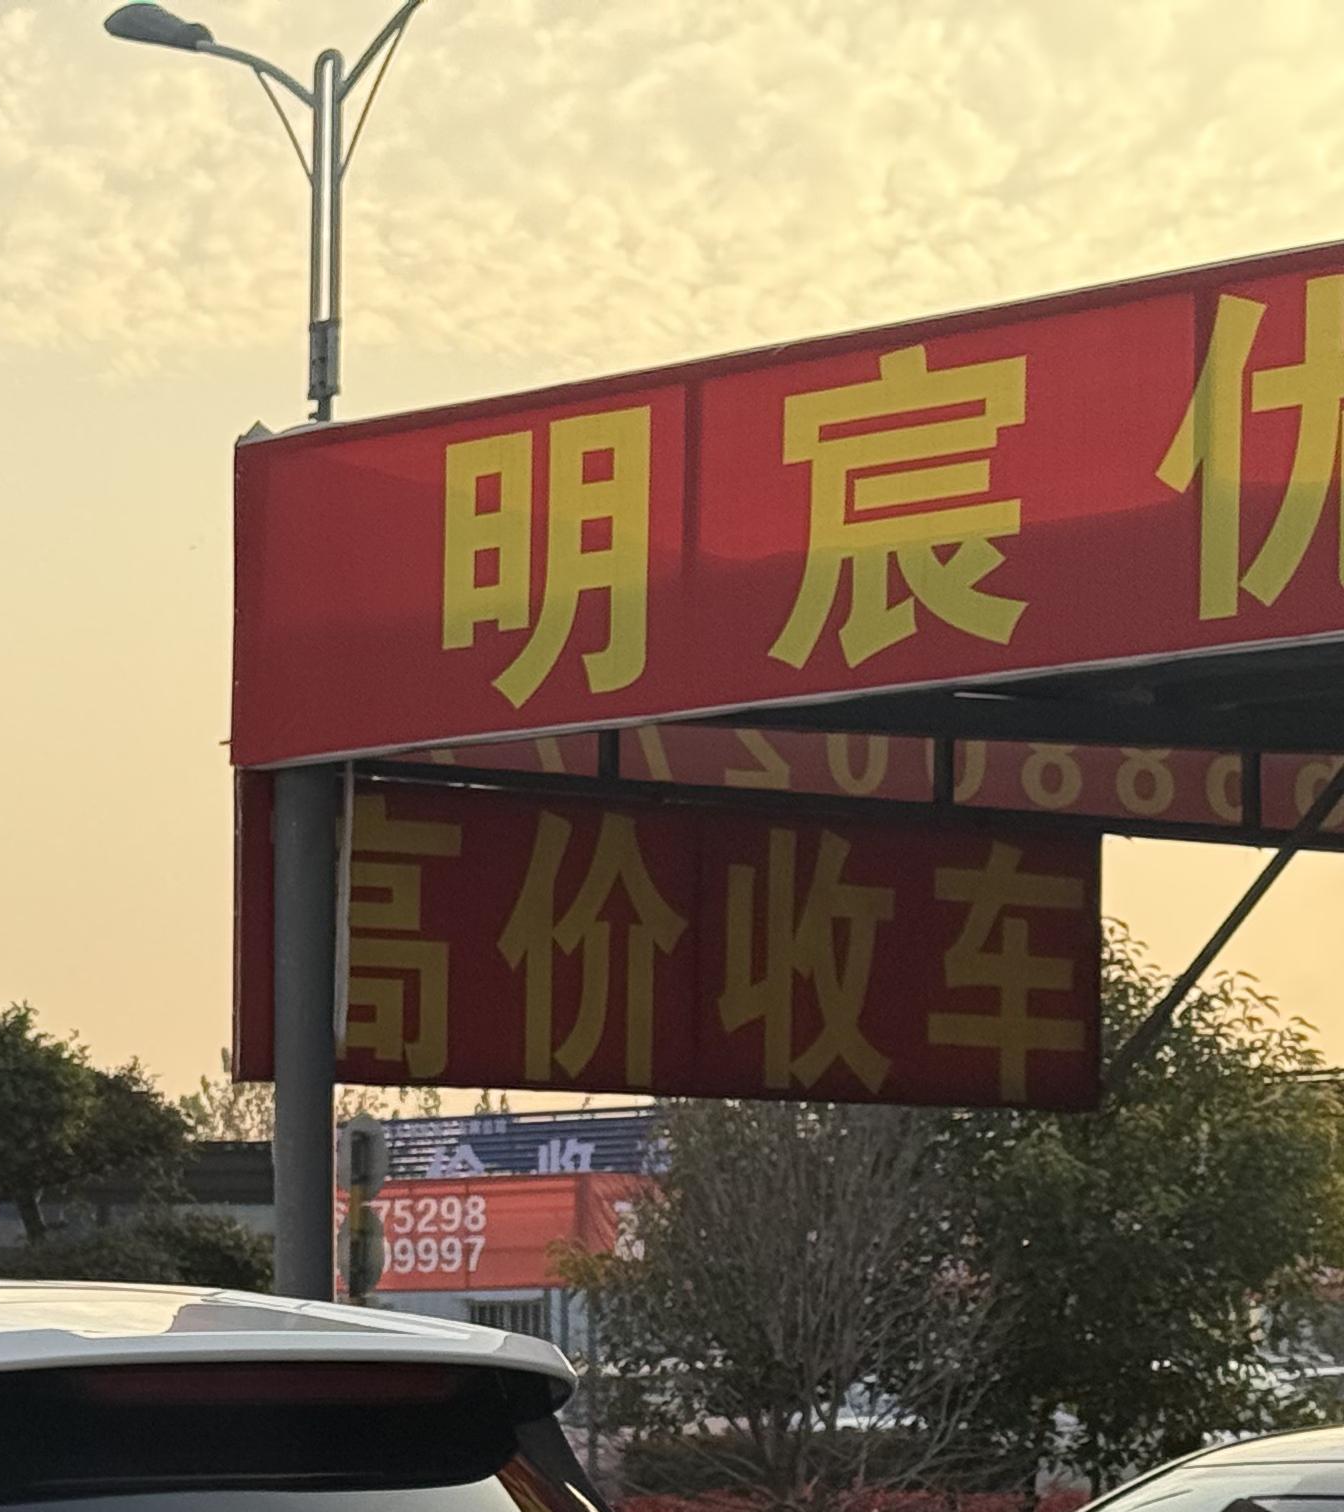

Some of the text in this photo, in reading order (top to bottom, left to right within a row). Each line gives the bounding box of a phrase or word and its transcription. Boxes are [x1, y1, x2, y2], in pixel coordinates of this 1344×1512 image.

[334, 794, 1086, 1104] 高价收车
[368, 1195, 487, 1235] 75298
[382, 1235, 486, 1274] 9997
